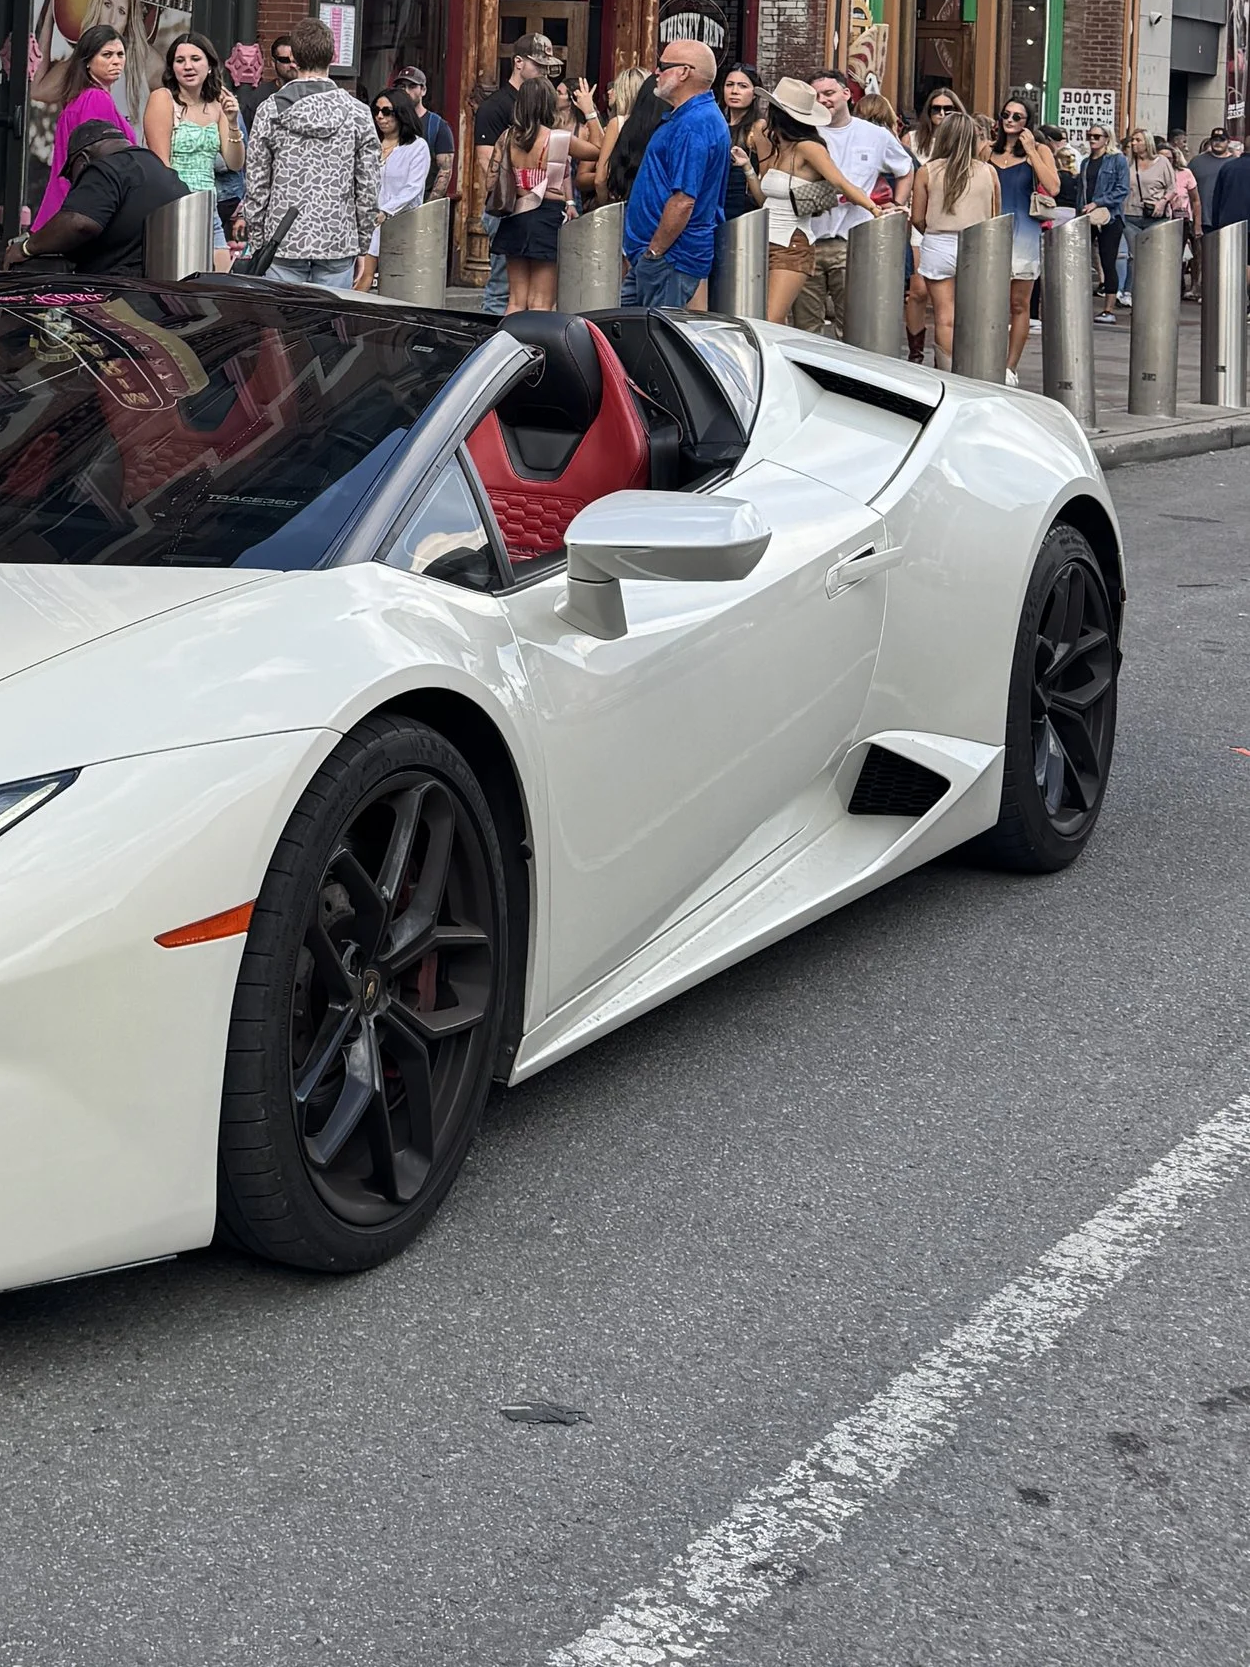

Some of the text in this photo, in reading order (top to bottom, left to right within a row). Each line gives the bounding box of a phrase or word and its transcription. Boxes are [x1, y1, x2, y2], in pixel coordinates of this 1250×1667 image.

[1062, 91, 1112, 105] BOOTS
[1060, 105, 1113, 116] Buy ONE Pair
